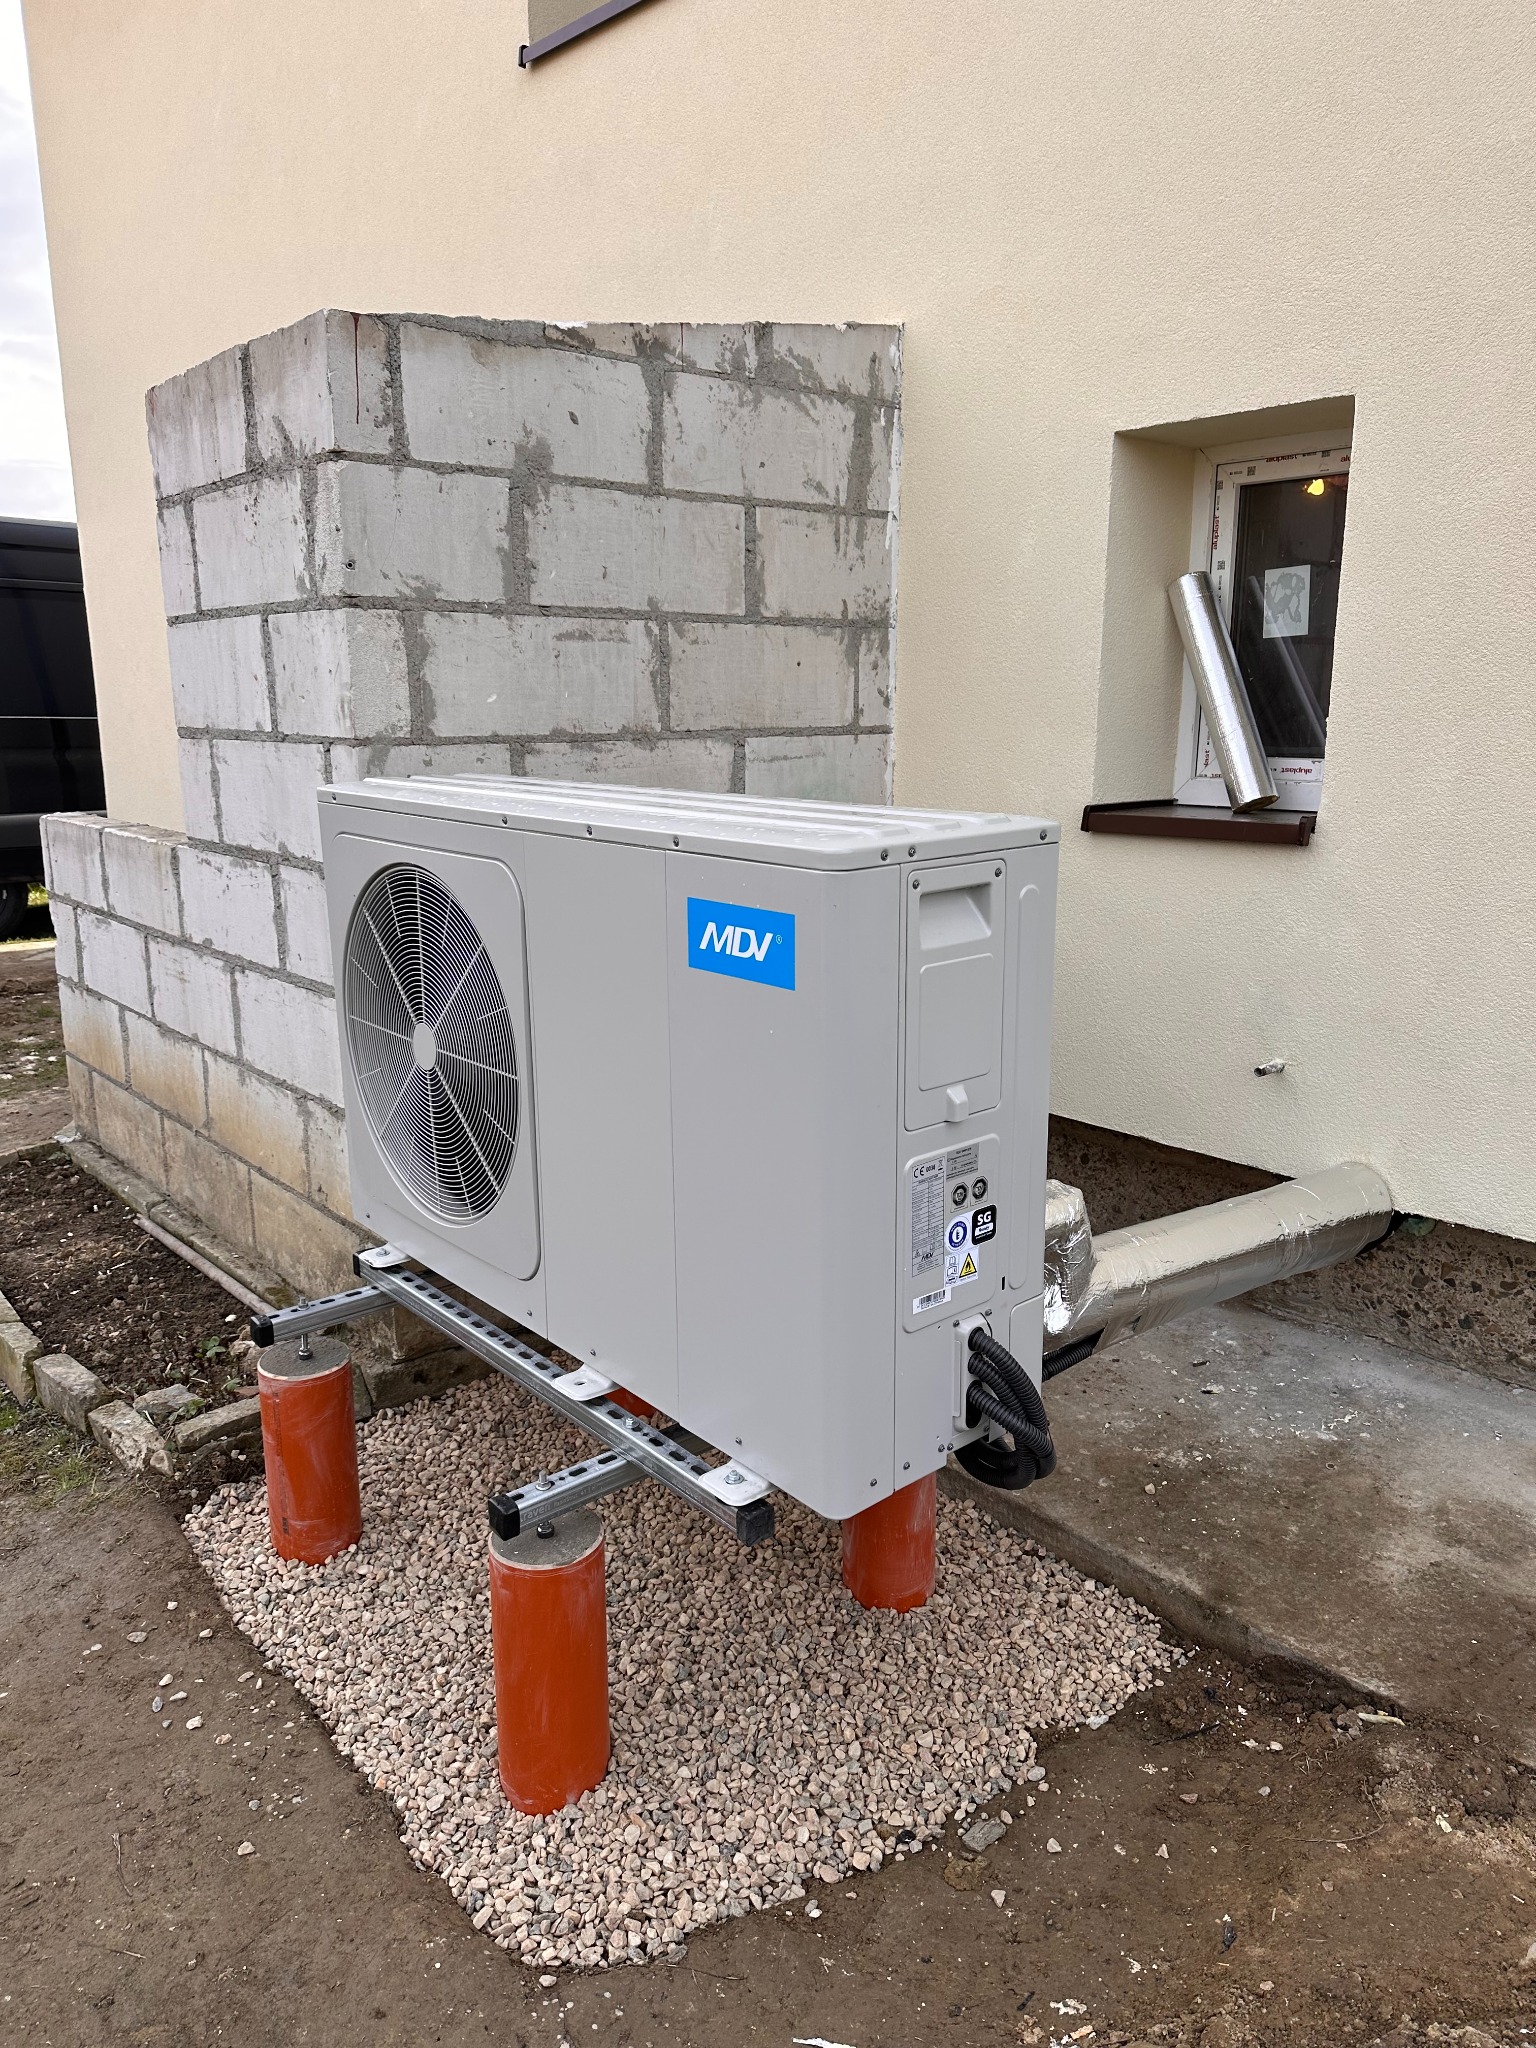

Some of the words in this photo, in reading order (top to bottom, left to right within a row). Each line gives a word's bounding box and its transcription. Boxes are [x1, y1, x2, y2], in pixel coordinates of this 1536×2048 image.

[1281, 767, 1312, 775] aluplast
[699, 921, 774, 962] MDV
[977, 1211, 992, 1226] SG
[520, 1504, 551, 1522] raven
